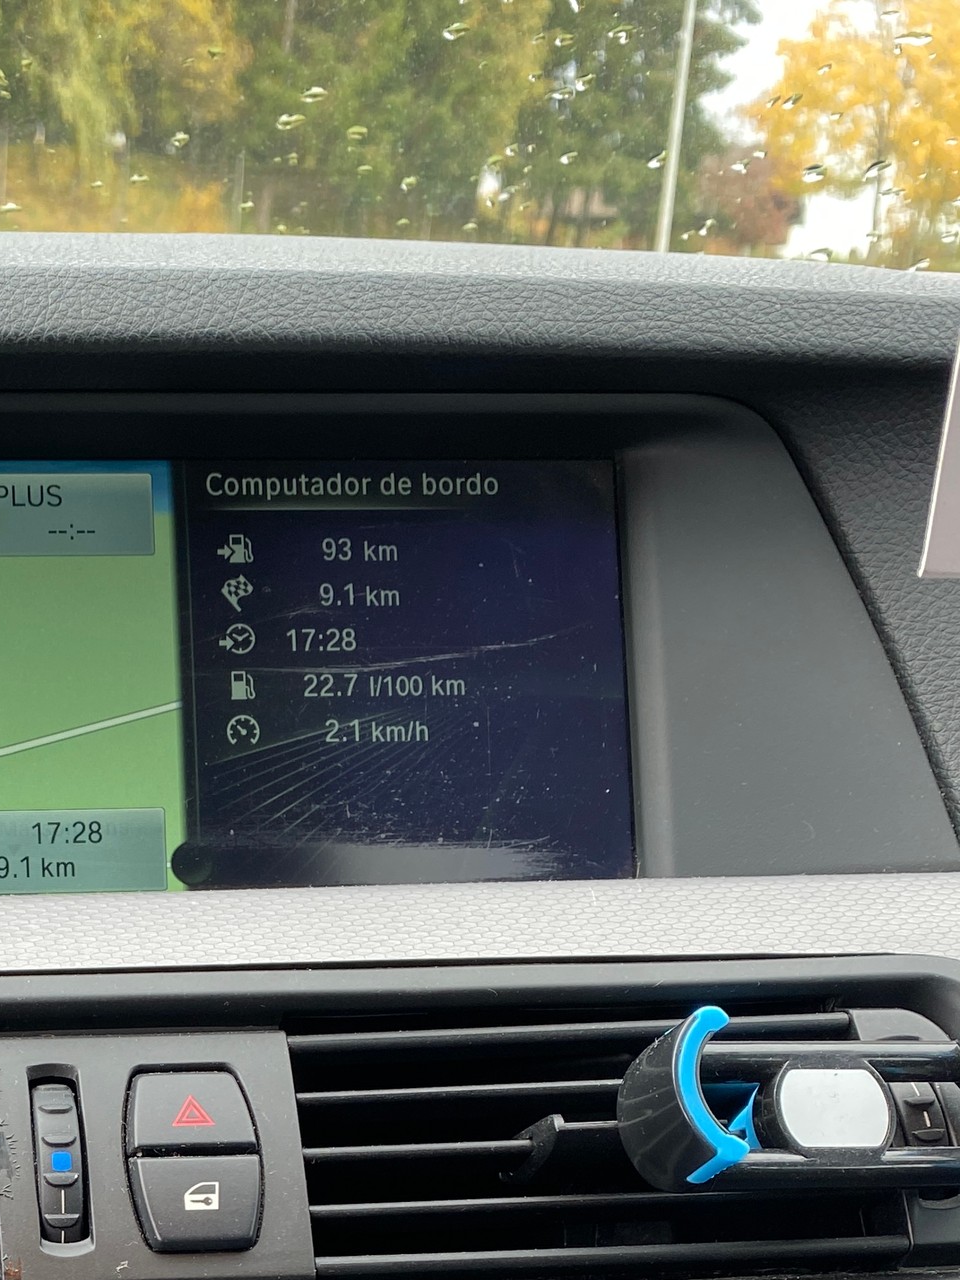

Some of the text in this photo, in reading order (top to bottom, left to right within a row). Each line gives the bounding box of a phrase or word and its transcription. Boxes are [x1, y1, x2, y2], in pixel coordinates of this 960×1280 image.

[205, 472, 499, 500] Computador de bordo
[321, 538, 398, 561] 93 km
[319, 584, 400, 606] 9.1 km
[286, 628, 357, 652] 17:28
[303, 675, 466, 698] 22.7 l/100 km
[325, 721, 429, 743] 2.1 km/h
[31, 820, 103, 845] 17:28
[41, 856, 76, 878] km
